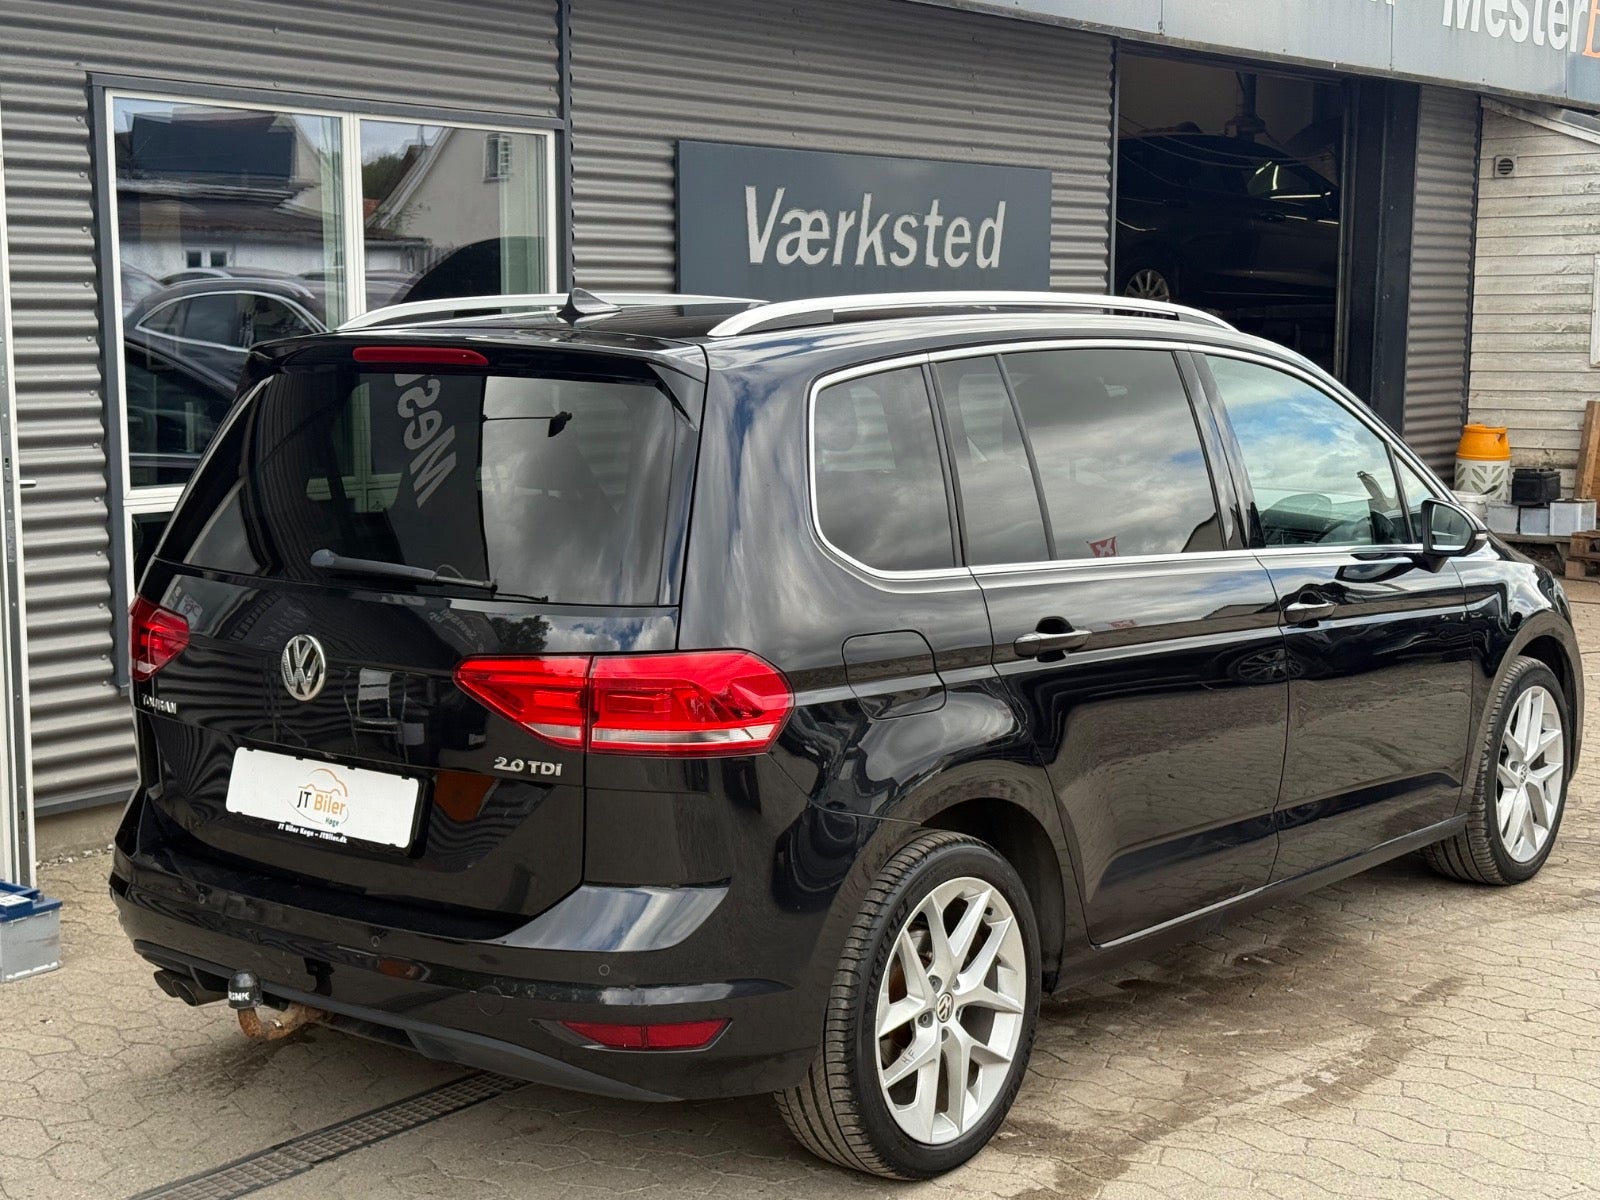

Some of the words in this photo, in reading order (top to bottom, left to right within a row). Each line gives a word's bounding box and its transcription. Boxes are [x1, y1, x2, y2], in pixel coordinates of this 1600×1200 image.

[745, 185, 1006, 269] Værksted
[297, 790, 312, 808] JT
[314, 793, 346, 815] Biler
